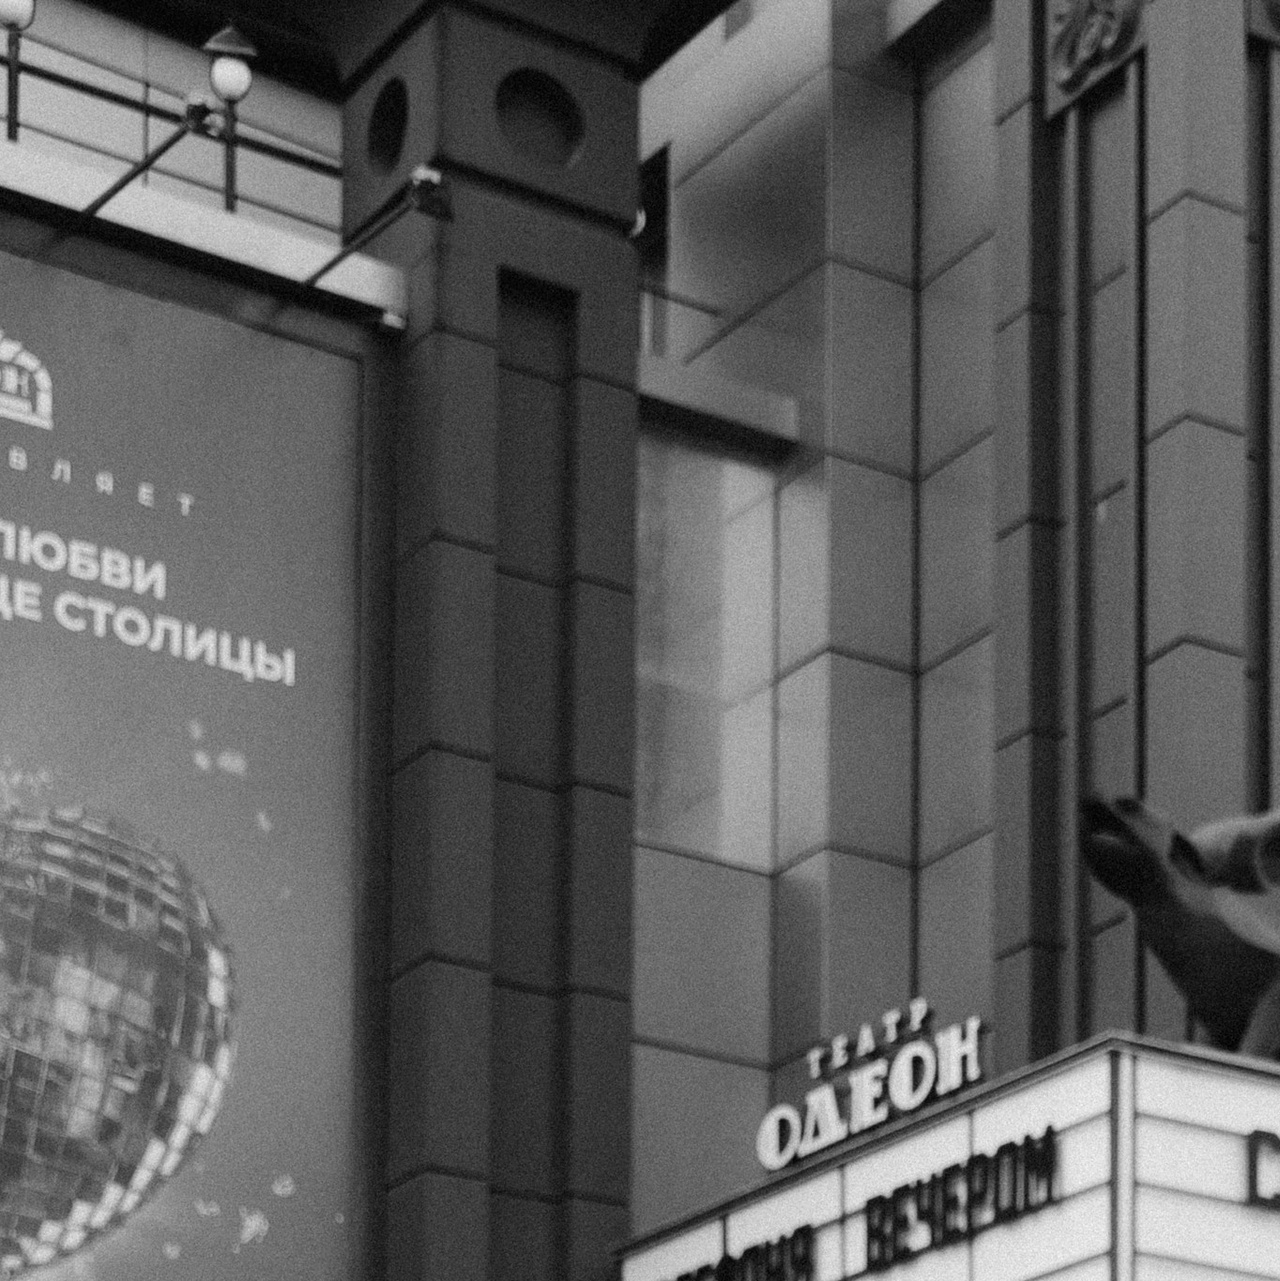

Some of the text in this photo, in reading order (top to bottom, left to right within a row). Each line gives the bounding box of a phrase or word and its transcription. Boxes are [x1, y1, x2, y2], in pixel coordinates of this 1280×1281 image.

[53, 590, 295, 687] СТОЛИЦЫ
[756, 1014, 983, 1171] ОДЕОН
[865, 1123, 1060, 1274] ВЕЧЕРОМ
